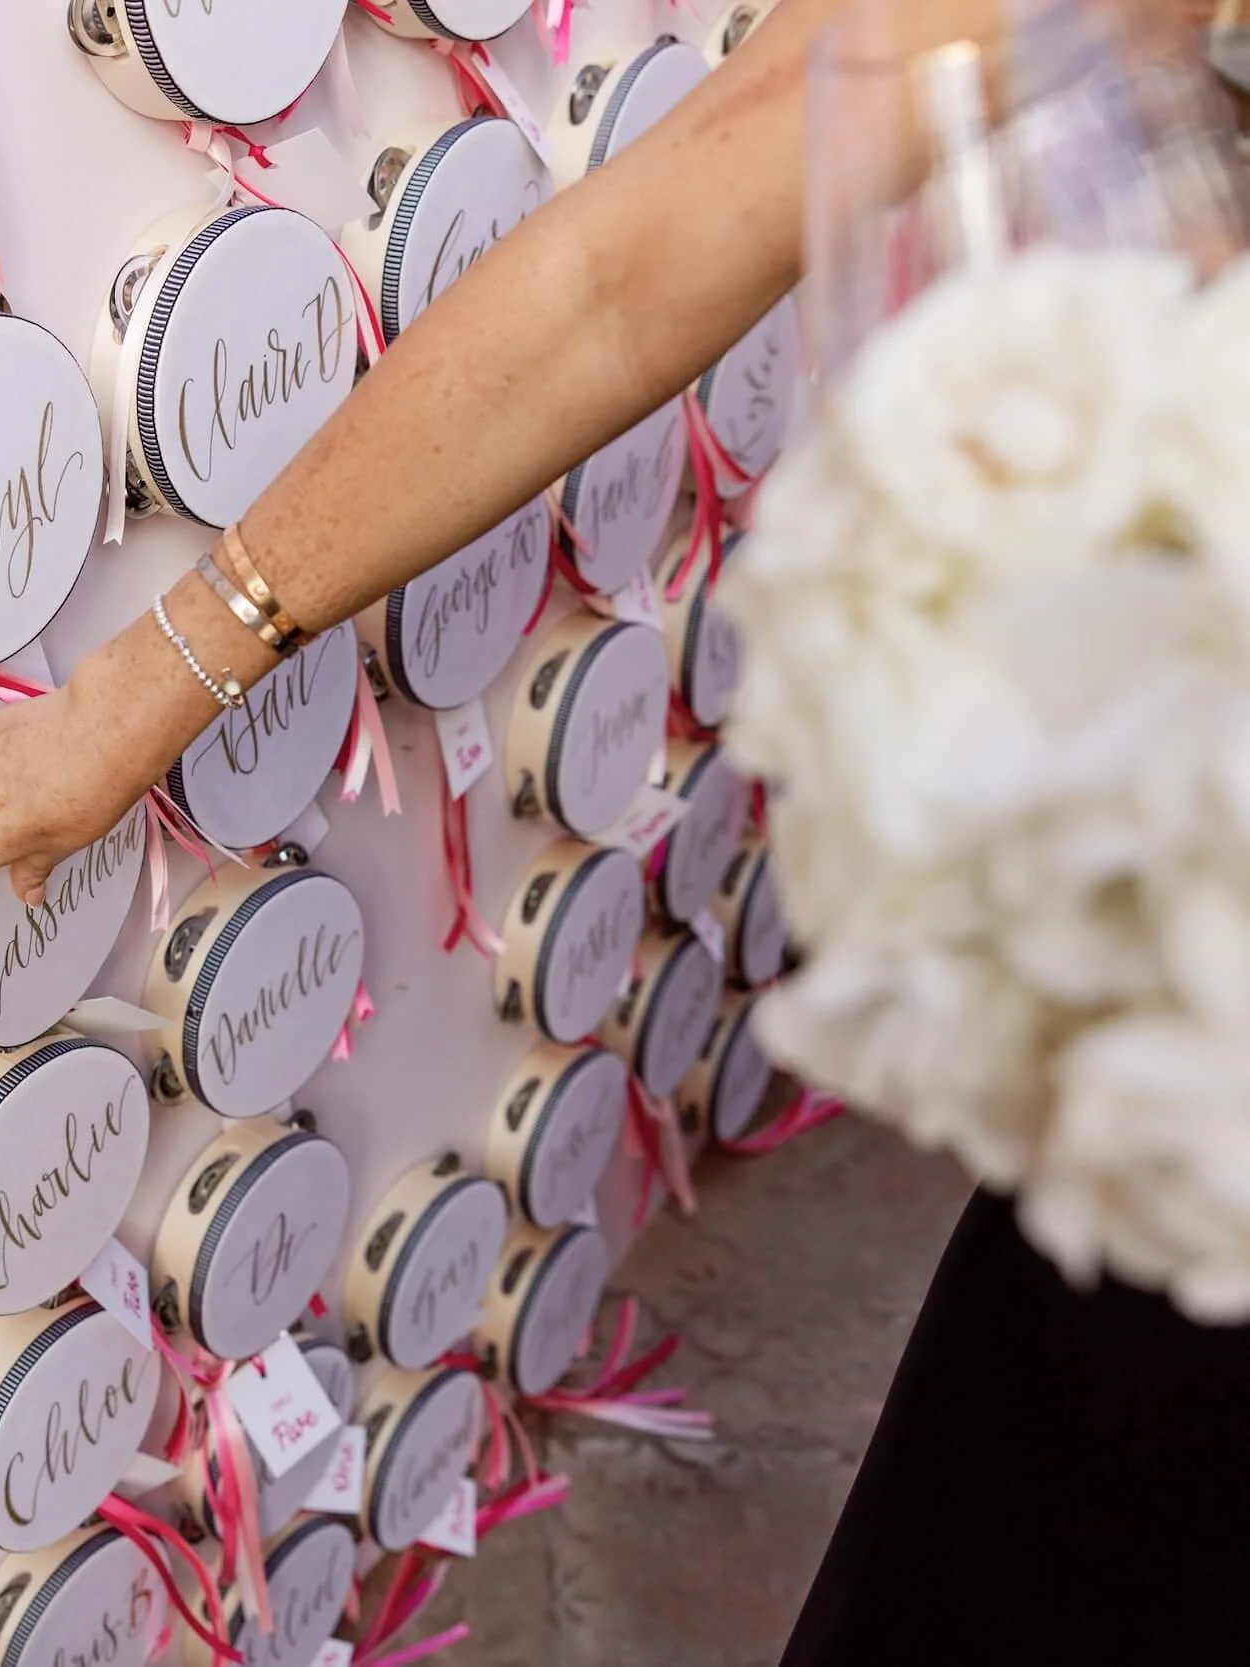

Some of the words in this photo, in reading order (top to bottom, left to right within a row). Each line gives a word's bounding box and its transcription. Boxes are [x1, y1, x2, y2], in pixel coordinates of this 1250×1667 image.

[179, 327, 311, 482] Claire
[302, 275, 354, 384] D
[407, 549, 504, 680] George
[191, 625, 345, 776] Dan
[201, 922, 360, 1087] Danielle
[4, 1350, 152, 1527] Chloe
